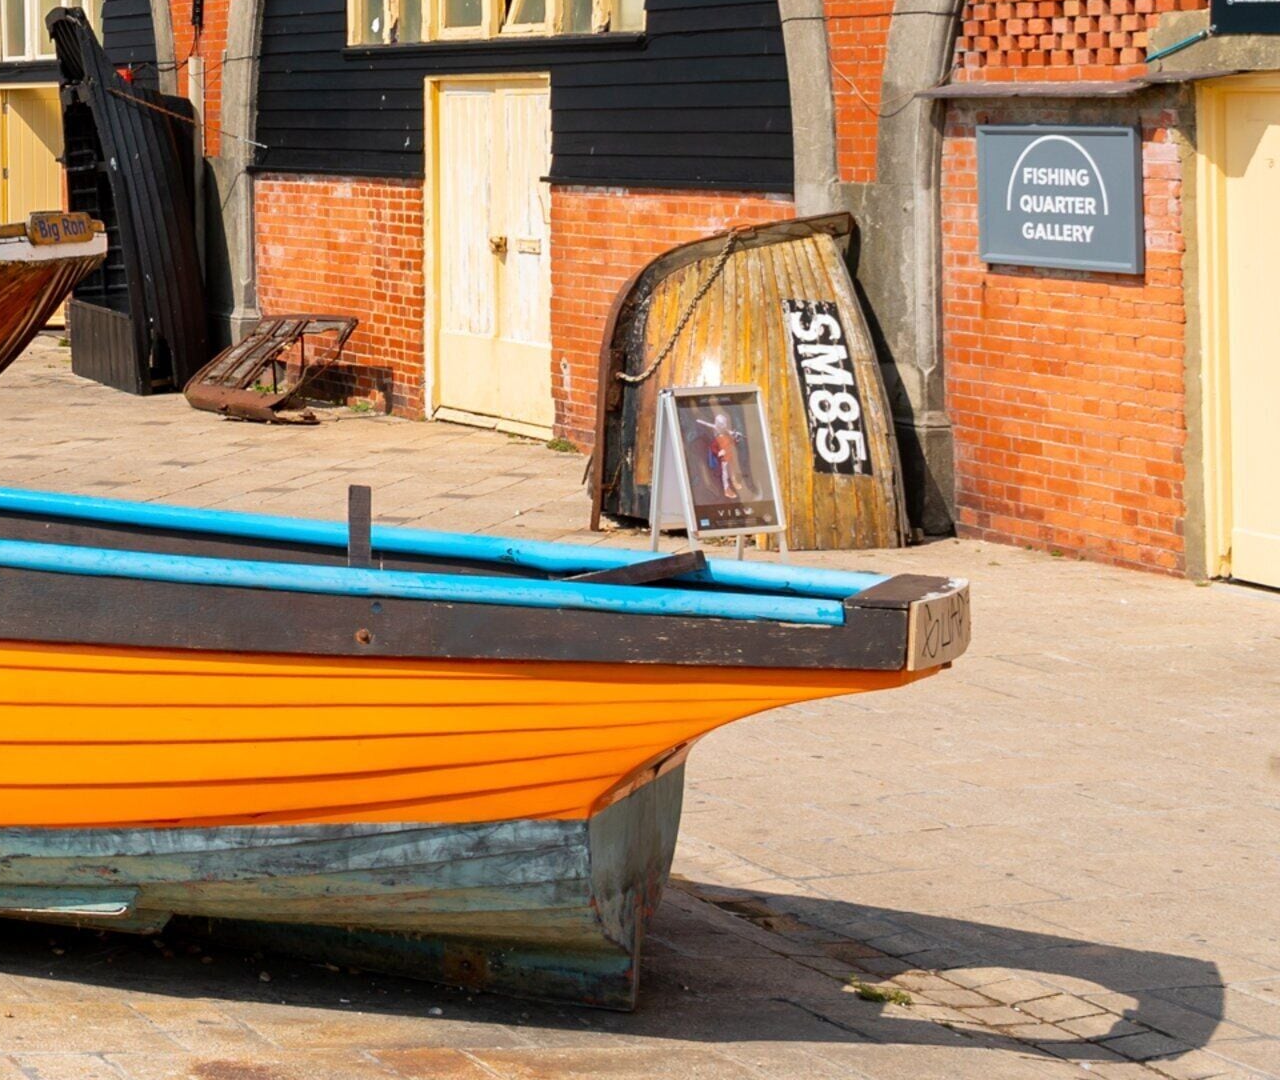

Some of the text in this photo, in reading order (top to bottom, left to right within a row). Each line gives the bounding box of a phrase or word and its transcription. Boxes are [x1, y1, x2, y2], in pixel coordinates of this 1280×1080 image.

[1023, 167, 1090, 186] FISHING
[1019, 194, 1096, 215] QUARTER
[38, 218, 87, 242] Big Ron
[1022, 221, 1094, 243] GALLERY
[790, 311, 867, 463] SM85
